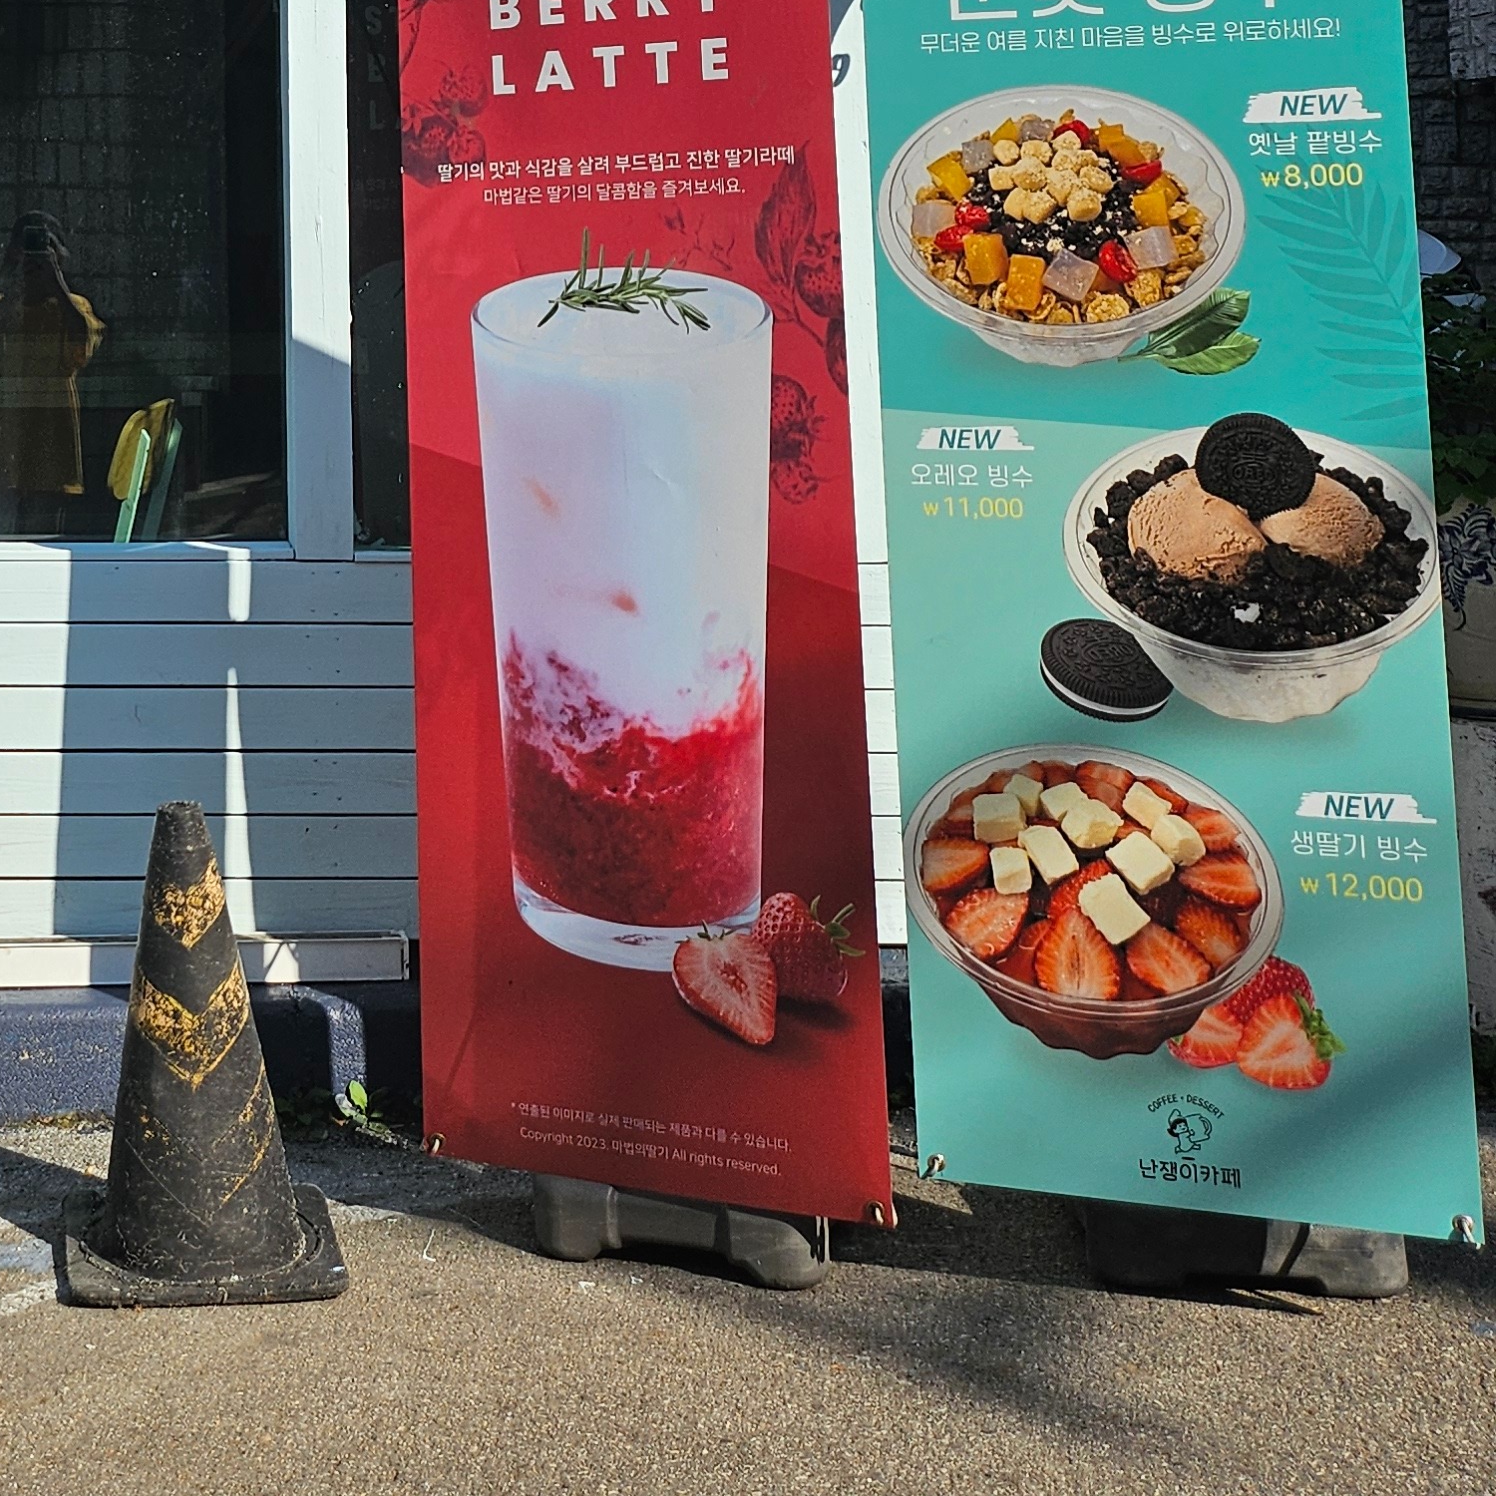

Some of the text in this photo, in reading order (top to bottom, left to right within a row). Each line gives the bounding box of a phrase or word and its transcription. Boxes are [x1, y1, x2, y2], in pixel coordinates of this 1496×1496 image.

[920, 17, 1341, 55] 무더운 여름 지친 마음을 빙수로 위로하세요!
[491, 36, 730, 97] LATTE
[1279, 93, 1349, 117] NEW
[1248, 129, 1384, 157] 옛날 팥빙수
[437, 144, 796, 184] 딸기의 맛과 식감을 살려 부드럽고 진한 딸기라떼
[483, 176, 746, 207] 마법같은 딸기의 달콤함을 즐겨보세요.
[938, 428, 1002, 450] NEW
[911, 463, 1034, 489] 오레오 빙수
[1323, 794, 1395, 820] NEW
[1290, 829, 1429, 864] 생딸기 빙수
[518, 1102, 551, 1119] 연출된
[552, 1106, 596, 1124] 이미지로
[1147, 1093, 1225, 1120] COFFEE DESSERT
[519, 1126, 574, 1146] Copyright
[671, 1147, 687, 1162] All
[689, 1151, 725, 1168] rights
[726, 1157, 783, 1177] reserved.
[1139, 1156, 1242, 1189] 난쟁이카페
